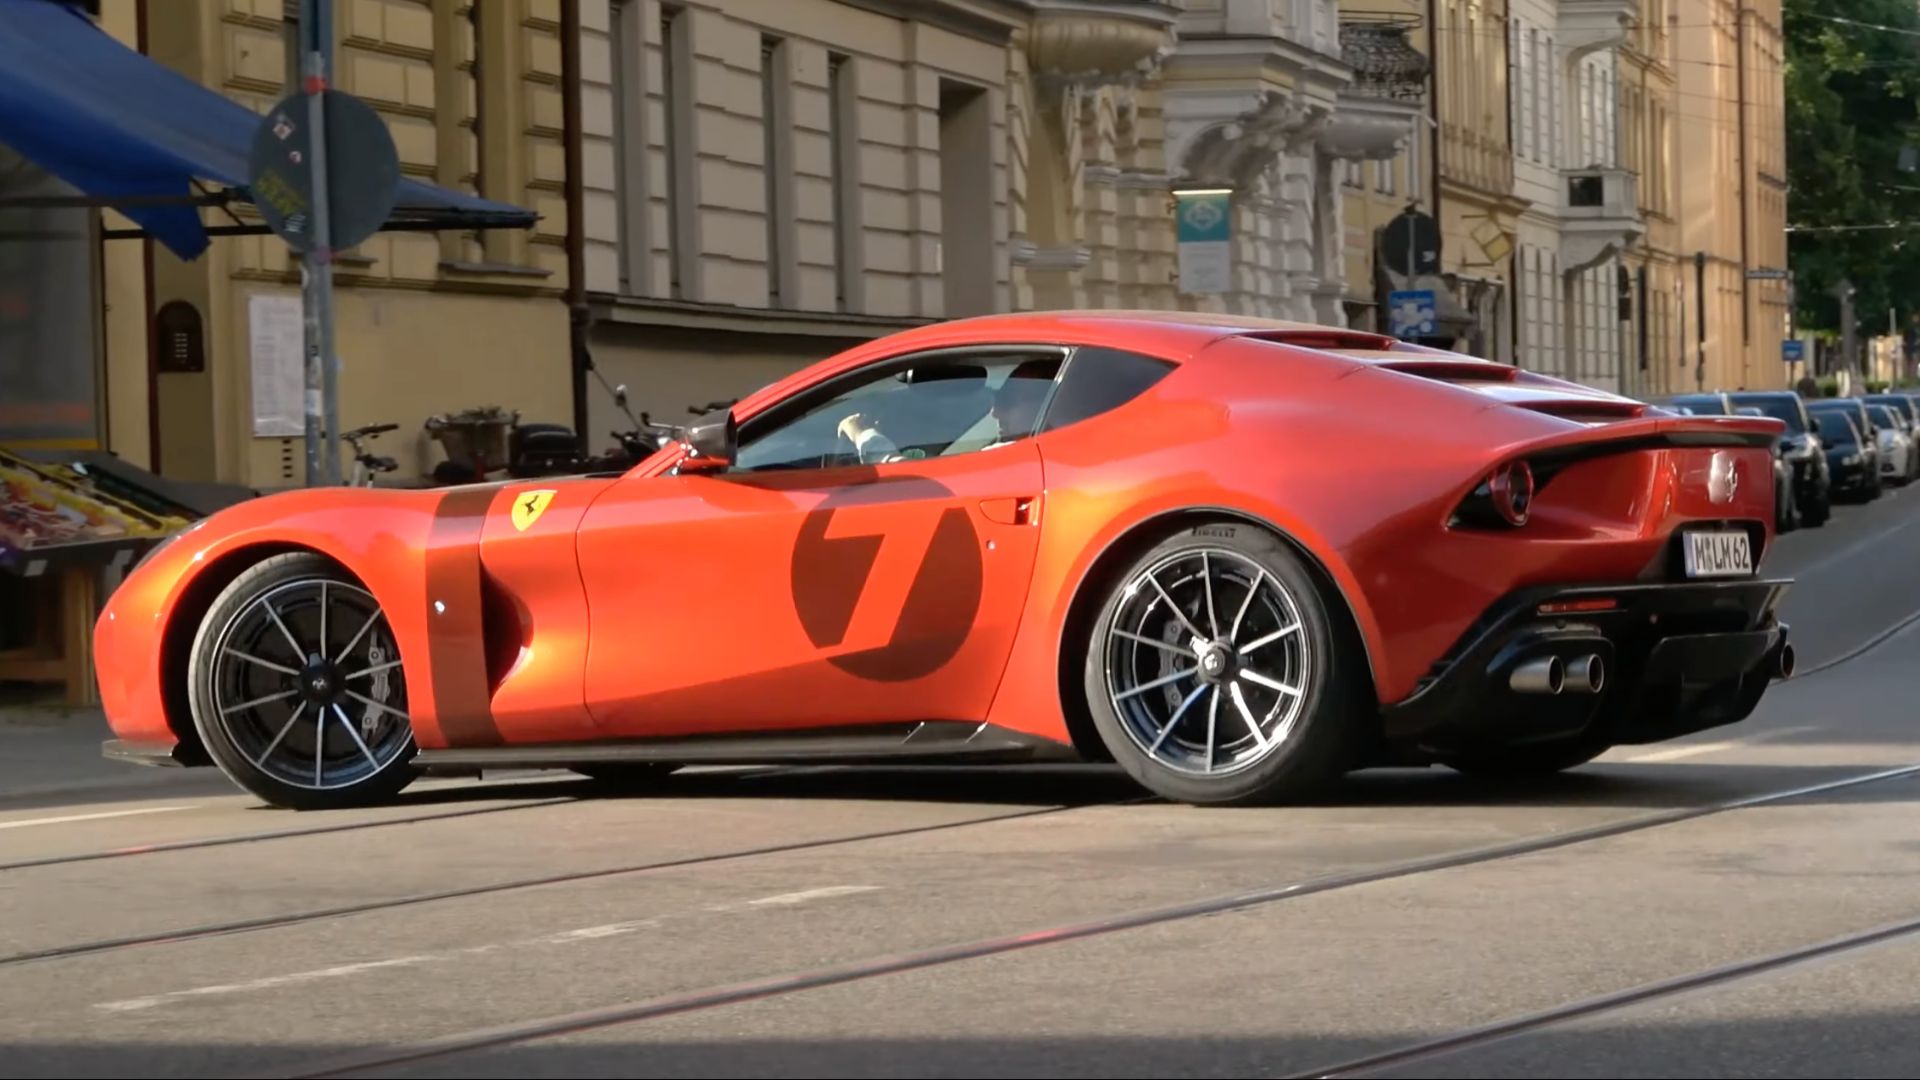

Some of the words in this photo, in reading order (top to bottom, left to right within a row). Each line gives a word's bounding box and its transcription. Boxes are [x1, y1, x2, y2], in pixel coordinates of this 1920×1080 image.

[823, 501, 949, 647] 7
[1694, 537, 1706, 570] M
[1733, 536, 1749, 569] 62
